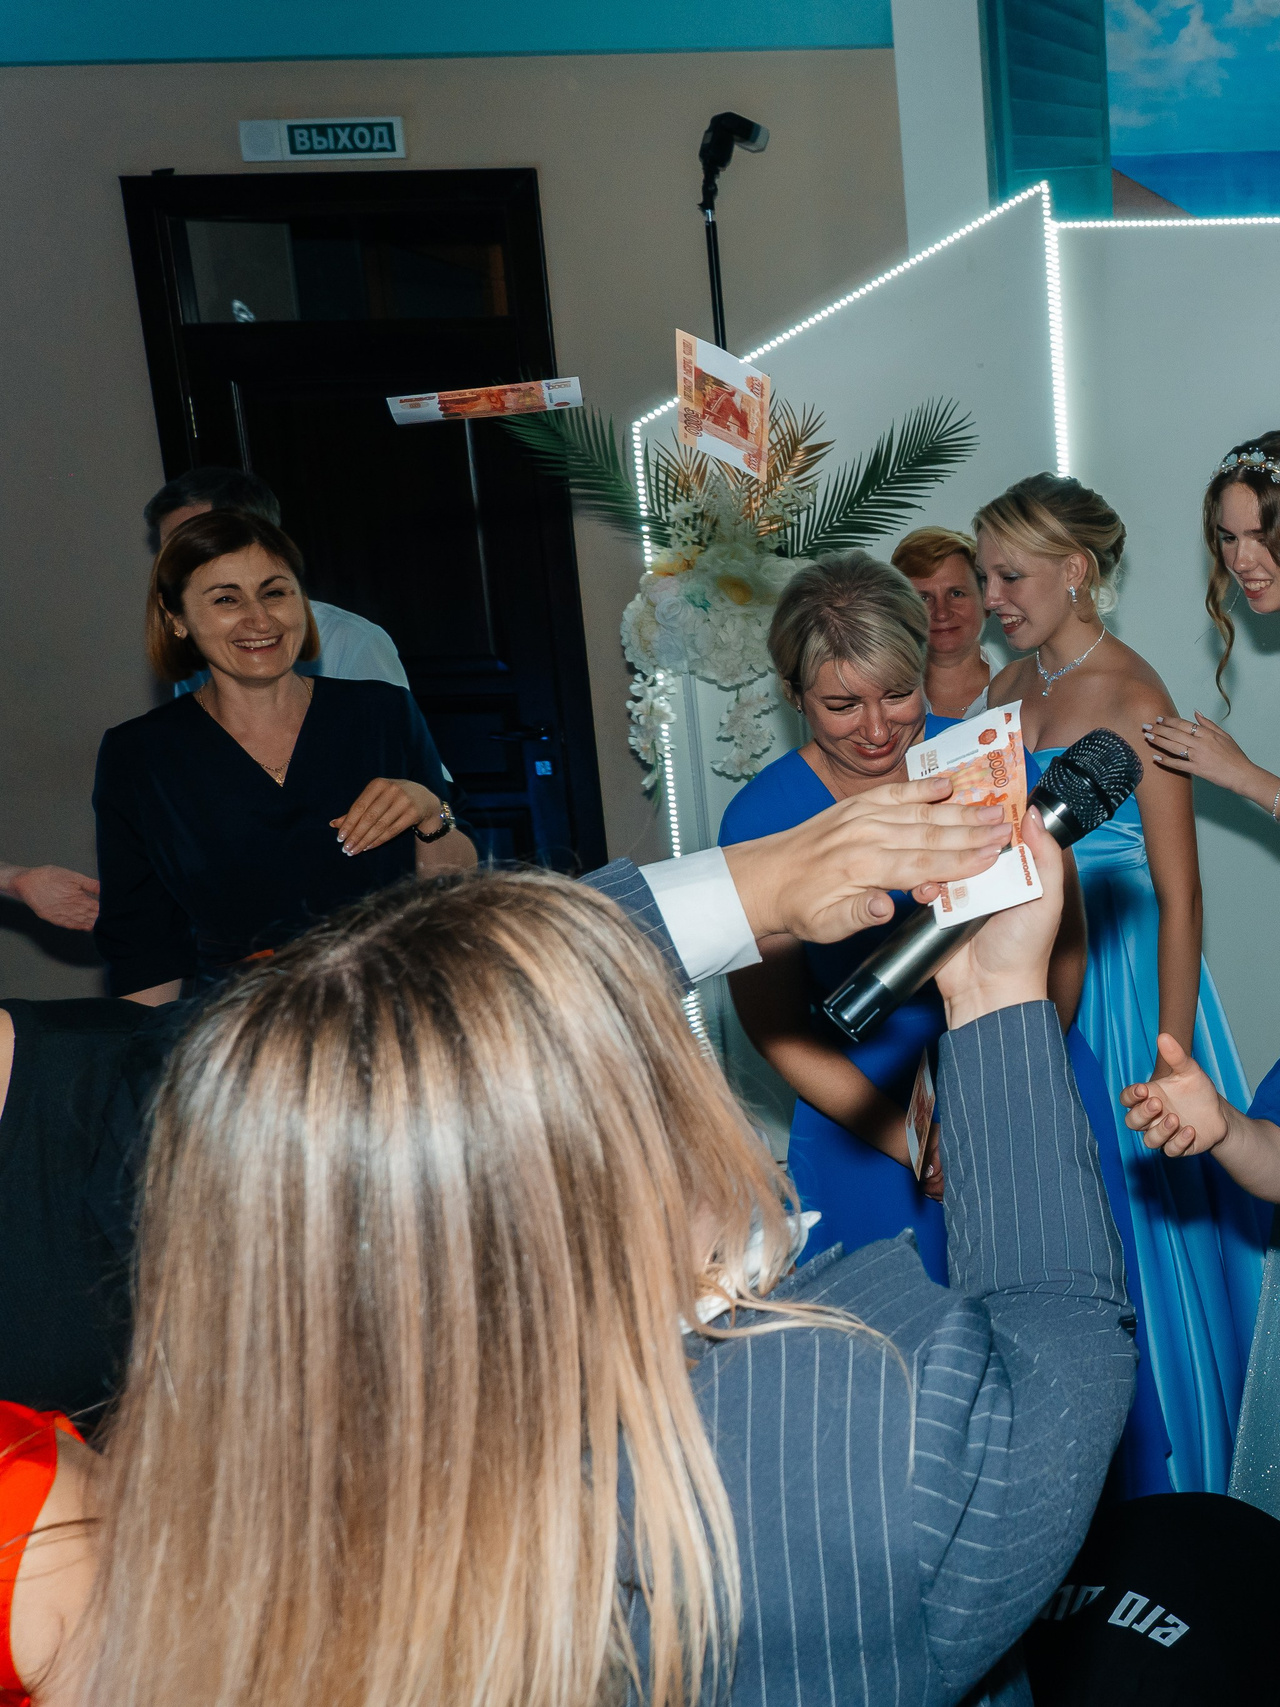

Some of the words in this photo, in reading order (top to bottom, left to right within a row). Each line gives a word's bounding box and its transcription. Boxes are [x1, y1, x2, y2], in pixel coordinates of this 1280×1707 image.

[294, 126, 392, 151] ВЫХОД
[684, 407, 703, 437] 5000
[987, 749, 1009, 787] 5000
[1016, 845, 1033, 886] ПРИКОЛОВ
